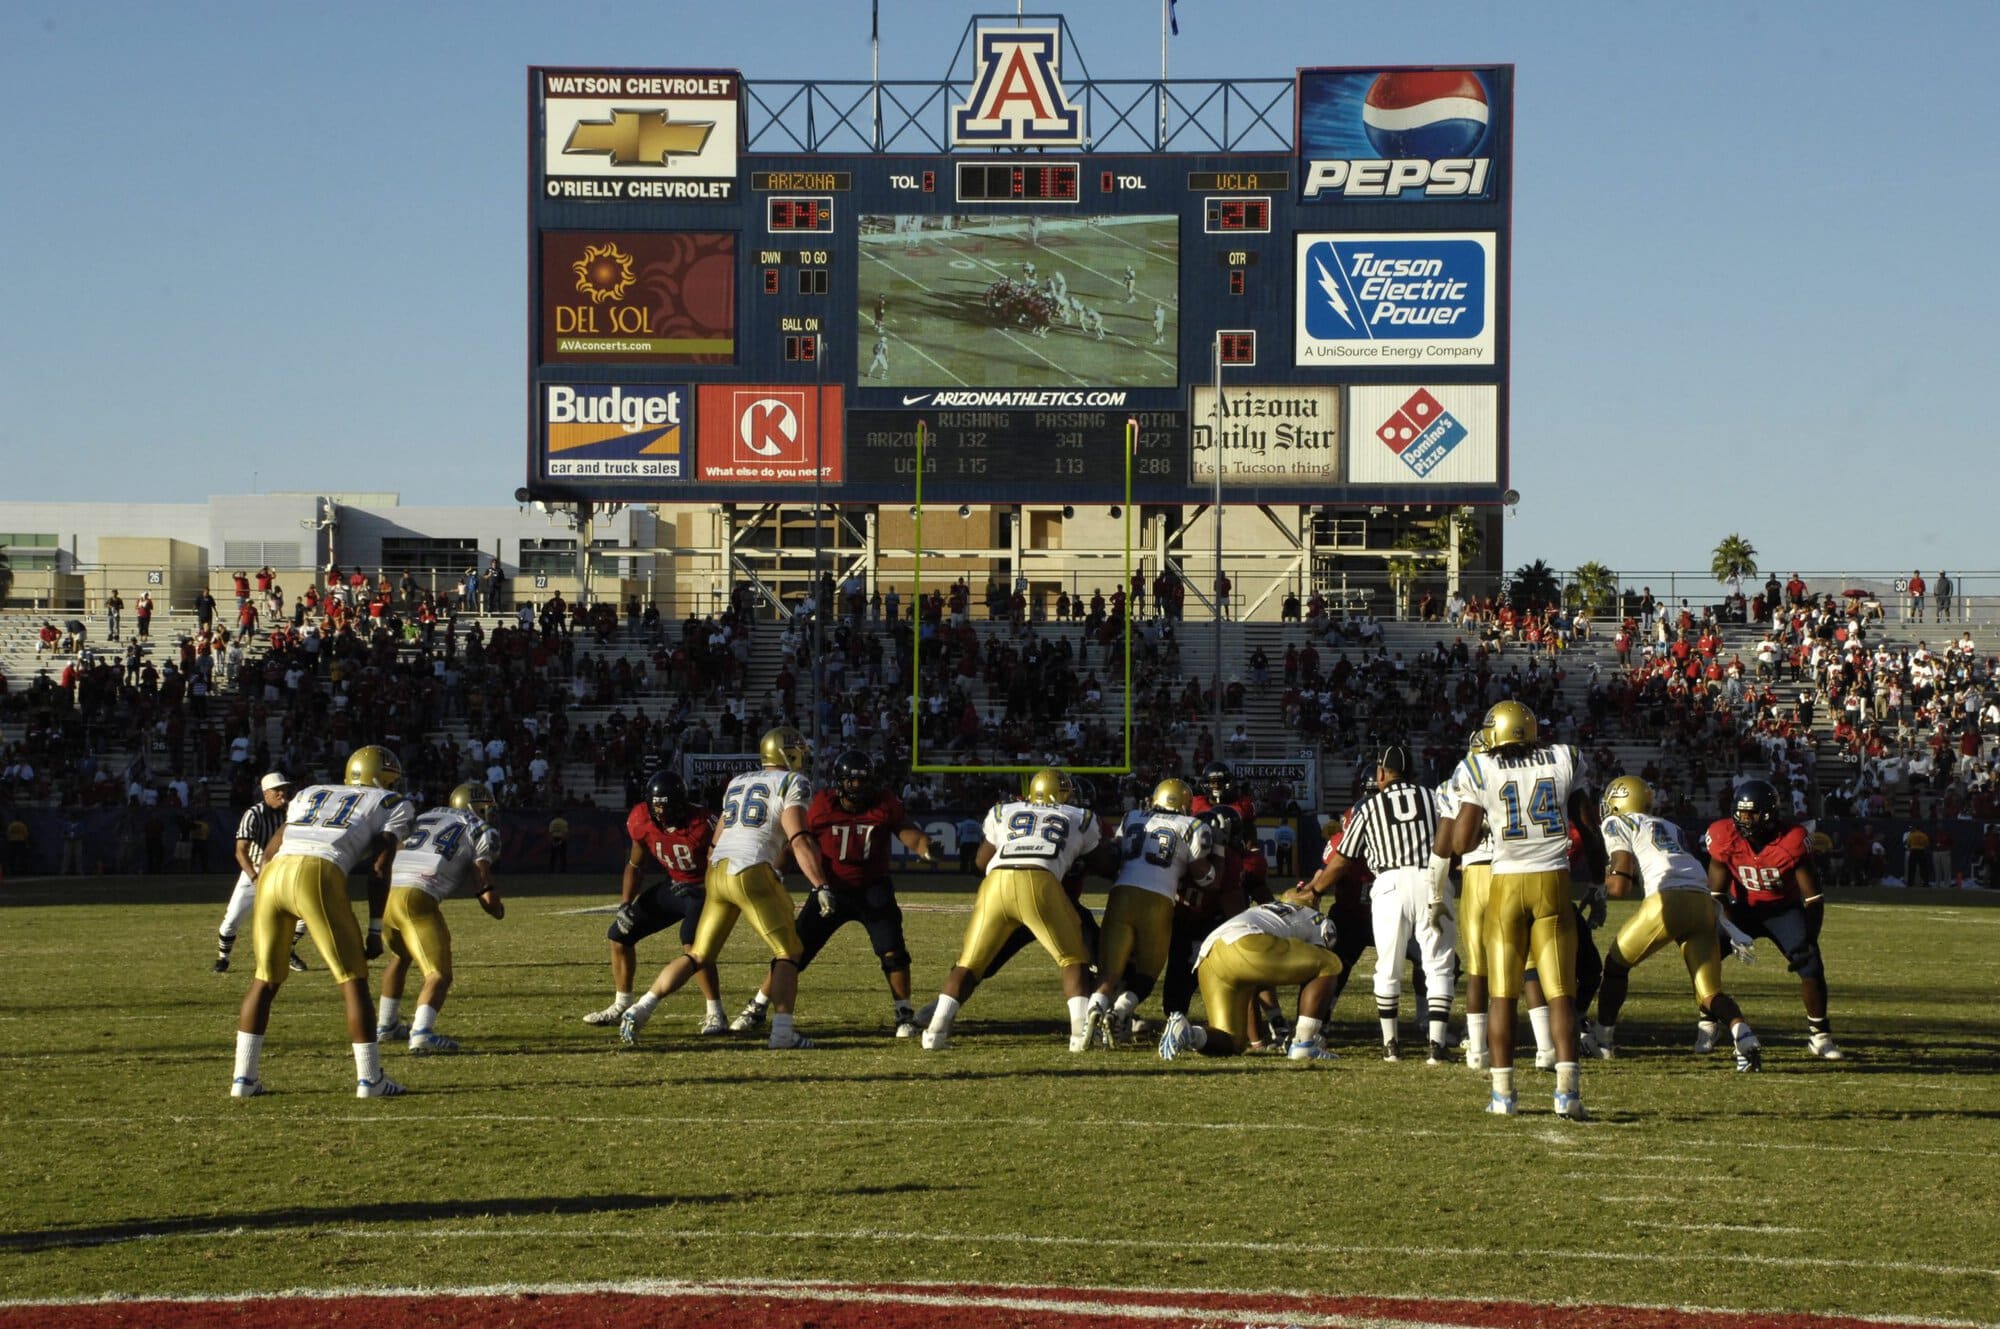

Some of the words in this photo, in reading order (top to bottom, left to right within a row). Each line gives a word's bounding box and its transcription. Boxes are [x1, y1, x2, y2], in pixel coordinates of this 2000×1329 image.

[548, 77, 621, 93] WATSON
[626, 78, 730, 95] CHEVROLET
[956, 32, 1079, 139] A
[768, 174, 836, 190] ARIZONA
[889, 175, 920, 190] TOL
[1116, 175, 1147, 190] TOL
[1216, 174, 1258, 190] UCLA
[1303, 158, 1490, 196] PEPSI
[547, 180, 623, 196] O'RIELLY
[627, 182, 731, 198] CHEVROLET
[772, 201, 818, 228] 34
[1221, 201, 1268, 228] 27
[761, 251, 781, 264] DWN
[800, 251, 811, 264] TO
[814, 251, 828, 264] GO
[1229, 252, 1247, 265] QTR
[1351, 252, 1443, 277] Tucson
[1360, 277, 1468, 301] Electric
[556, 306, 600, 333] DEL
[609, 306, 654, 333] SOL
[1370, 301, 1467, 325] Power
[782, 318, 803, 331] BALL
[805, 318, 818, 331] ON
[560, 341, 652, 351] AVAconcerts.com
[1305, 346, 1313, 356] A
[1317, 346, 1378, 357] UniSource
[1382, 345, 1423, 359] Energy
[1426, 345, 1483, 358] Company
[931, 391, 1127, 407] ARIZONAATHLETICS.COM
[1207, 390, 1319, 418] Arizona
[548, 386, 680, 433] Budget
[938, 412, 1010, 427] RUSHING
[1036, 412, 1106, 427] PASSING
[866, 432, 937, 448] ARIZOA
[957, 432, 988, 448] 132
[1056, 432, 1084, 448] 341
[1192, 423, 1267, 456] Daily
[1273, 423, 1336, 450] Star
[1403, 418, 1453, 464] Domino's
[551, 463, 571, 474] car
[576, 462, 600, 474] and
[604, 462, 639, 474] truck
[642, 462, 678, 474] sales
[894, 457, 937, 473] UCA
[1192, 462, 1214, 474] It's
[1220, 464, 1228, 474] a
[1233, 461, 1286, 474] Tucson
[1413, 445, 1447, 475] Pizza
[705, 467, 734, 476] What
[736, 467, 758, 476] else
[760, 467, 774, 476] do
[776, 468, 797, 479] you
[149, 571, 160, 583] 26
[536, 576, 547, 587] 27
[1501, 580, 1512, 592] 29
[1895, 580, 1907, 592] 30
[694, 760, 762, 774] BRUEGGER'S
[1843, 754, 1858, 764] 30
[1235, 766, 1305, 779] BRUEGGER'S
[286, 789, 366, 829] 11
[722, 782, 771, 829] 56
[1386, 788, 1416, 823] U
[1498, 776, 1567, 841] 14
[1007, 810, 1070, 851] 92
[402, 817, 468, 861] 54
[831, 823, 876, 862] 77
[655, 841, 698, 872] 48
